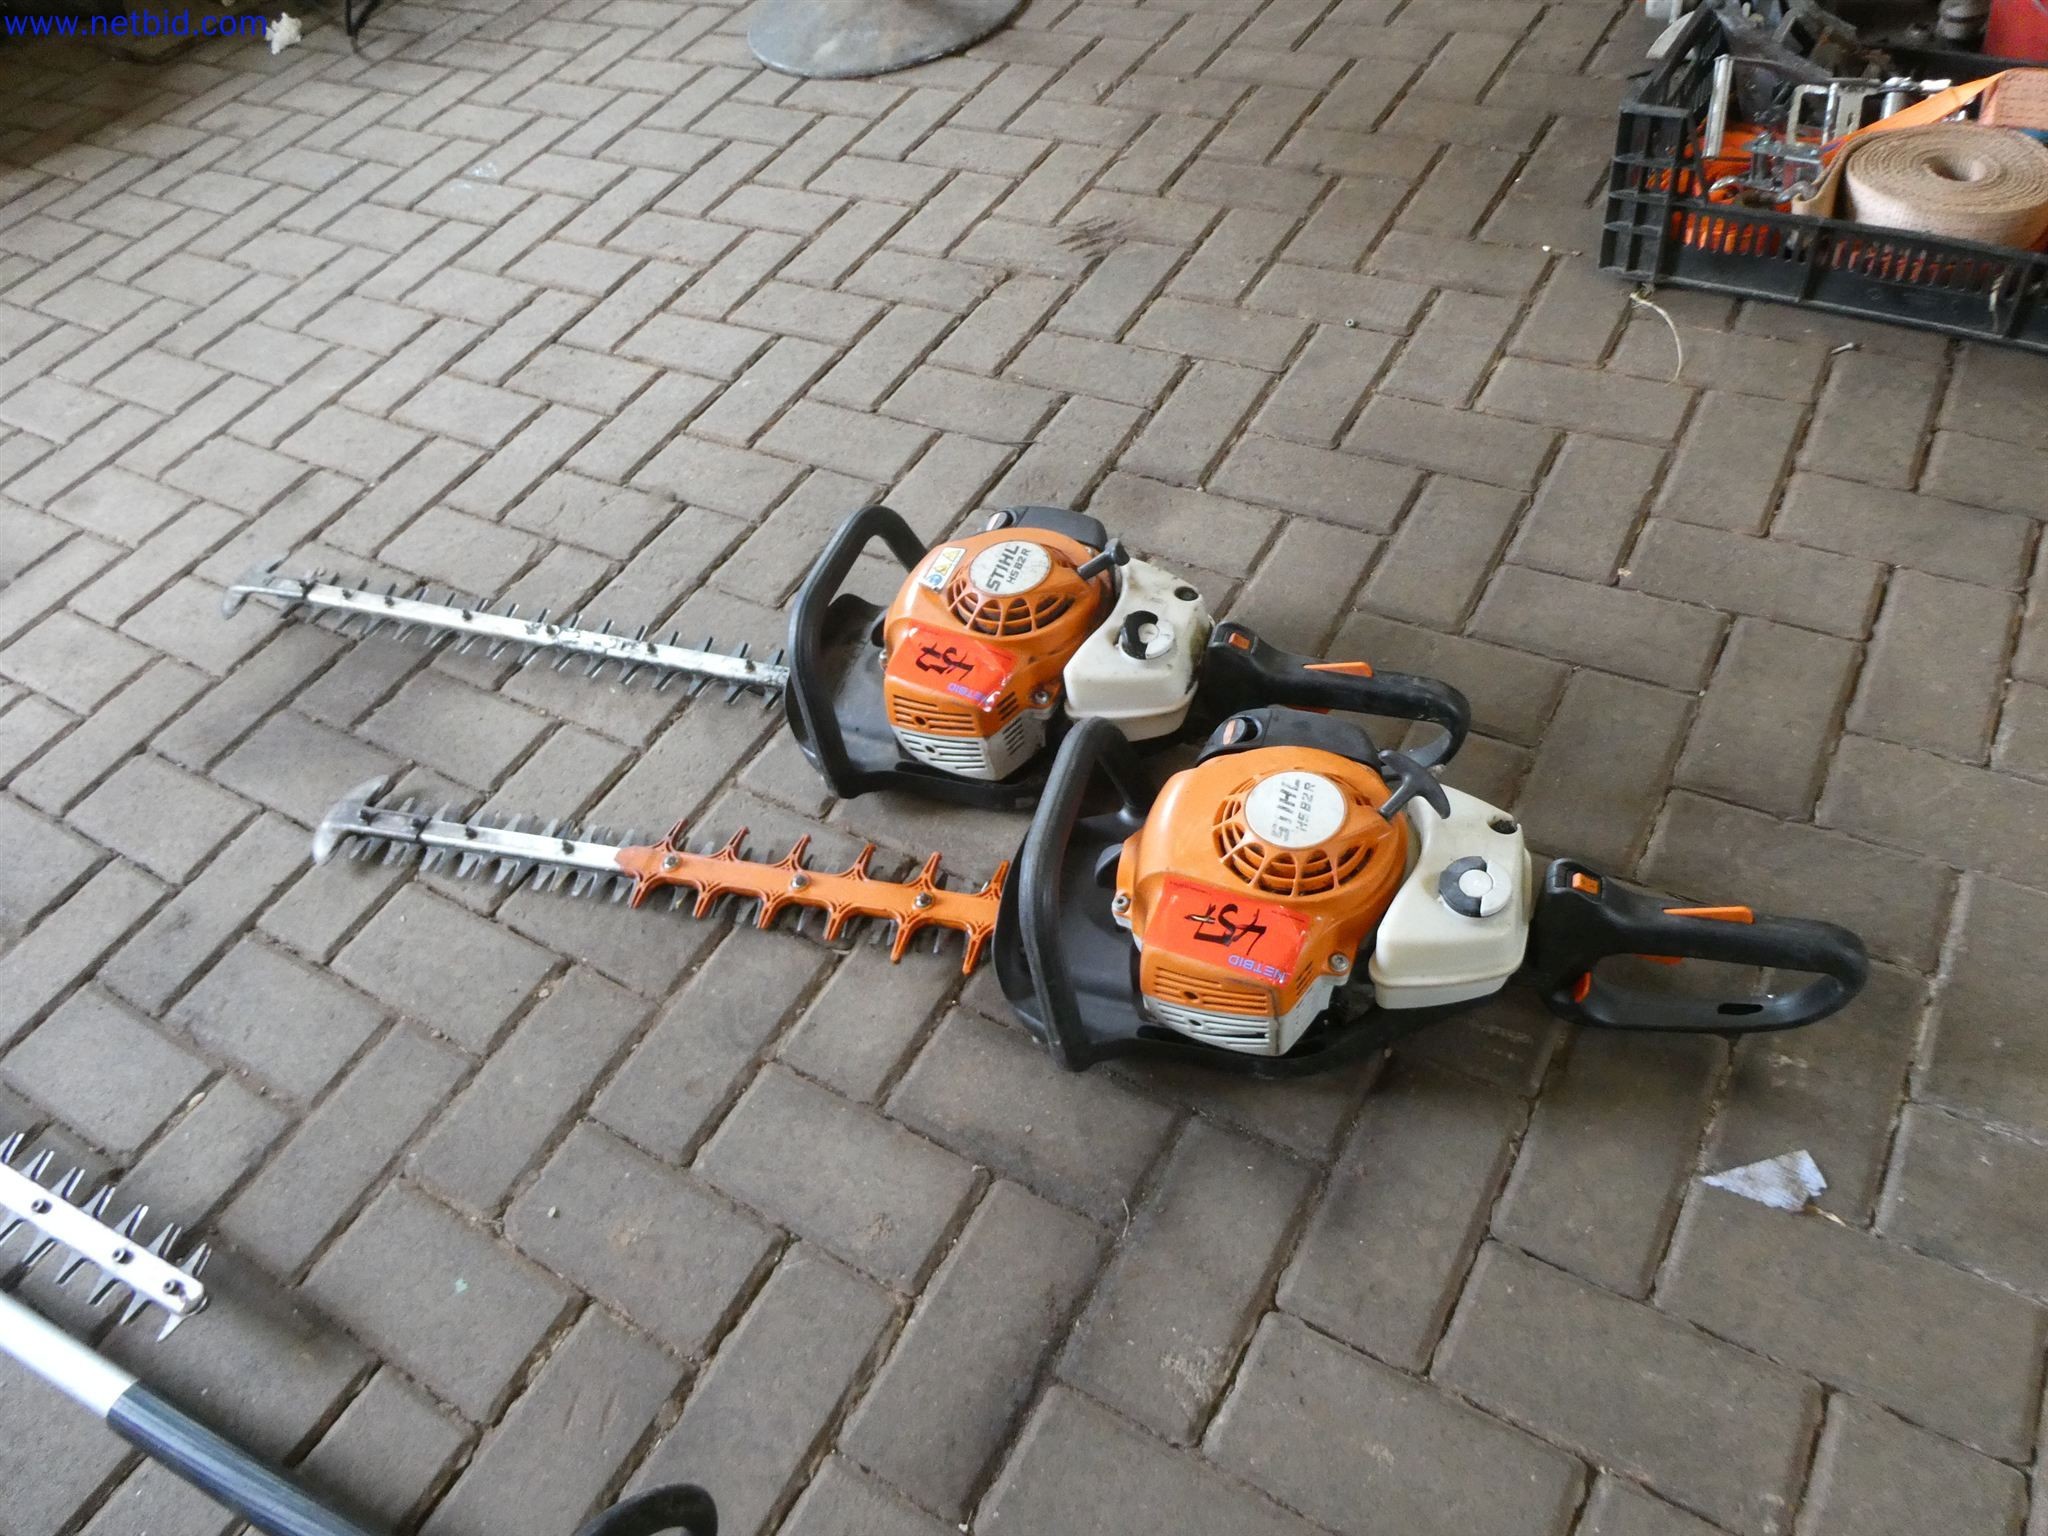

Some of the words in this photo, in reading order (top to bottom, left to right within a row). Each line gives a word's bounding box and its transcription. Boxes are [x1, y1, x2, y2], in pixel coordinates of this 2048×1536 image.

[986, 545, 1020, 592] STIHL
[1271, 779, 1300, 842] STIHL
[1184, 903, 1267, 955] 457
[1227, 954, 1286, 983] NETBID
